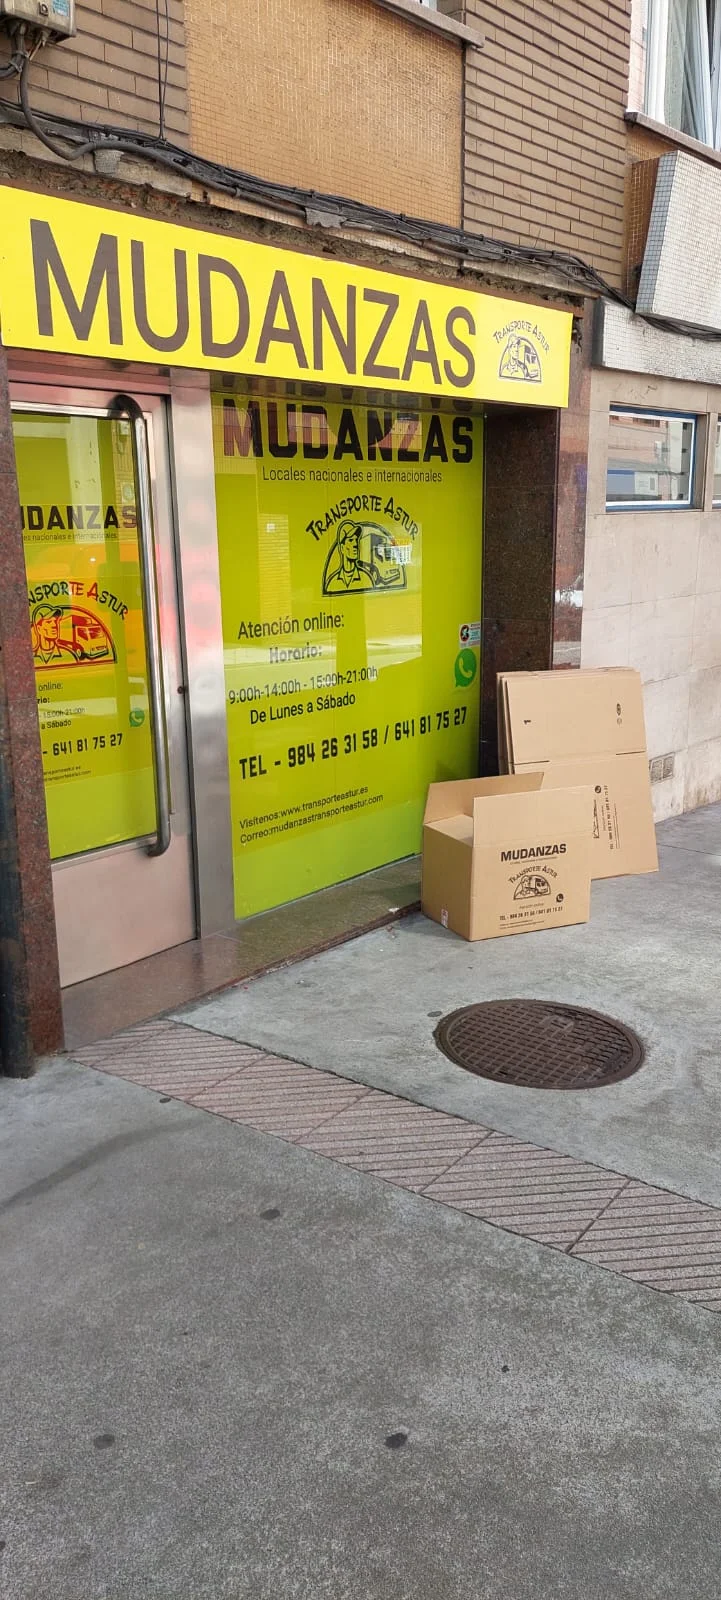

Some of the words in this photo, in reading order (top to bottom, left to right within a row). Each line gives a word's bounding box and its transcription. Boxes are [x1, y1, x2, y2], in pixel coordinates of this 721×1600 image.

[30, 219, 476, 388] MUDANZAS
[493, 320, 531, 343] TRANSPORTE
[223, 398, 473, 463] MUDANZAS
[262, 466, 306, 481] Locales
[309, 468, 363, 482] nacionales
[366, 473, 372, 482] e
[374, 468, 442, 482] internacionales
[306, 494, 382, 541] TRANSPORTE
[383, 497, 419, 540] ASTUR
[87, 582, 129, 620] ASTUR
[238, 615, 299, 640] Atención
[303, 612, 345, 632] online:
[269, 642, 322, 663] Horario:
[228, 678, 301, 704] 9:00h-14:00h
[310, 666, 378, 690] 15:00h-21:00h
[250, 709, 267, 724] De
[270, 701, 304, 720] Lunes
[306, 703, 314, 713] a
[316, 692, 356, 711] Sábado
[53, 741, 72, 756] 641
[77, 738, 88, 752] 81
[93, 736, 106, 750] 75
[110, 733, 123, 747] 27
[239, 755, 267, 779] TEL
[288, 742, 315, 767] 984
[322, 738, 338, 759] 26
[344, 732, 357, 754] 31
[362, 729, 378, 749] 58
[384, 725, 390, 744] /
[395, 722, 415, 741] 641
[420, 715, 431, 734] 81
[437, 710, 450, 730] 75
[454, 706, 467, 725] 27
[500, 844, 566, 862] MUDANZAS
